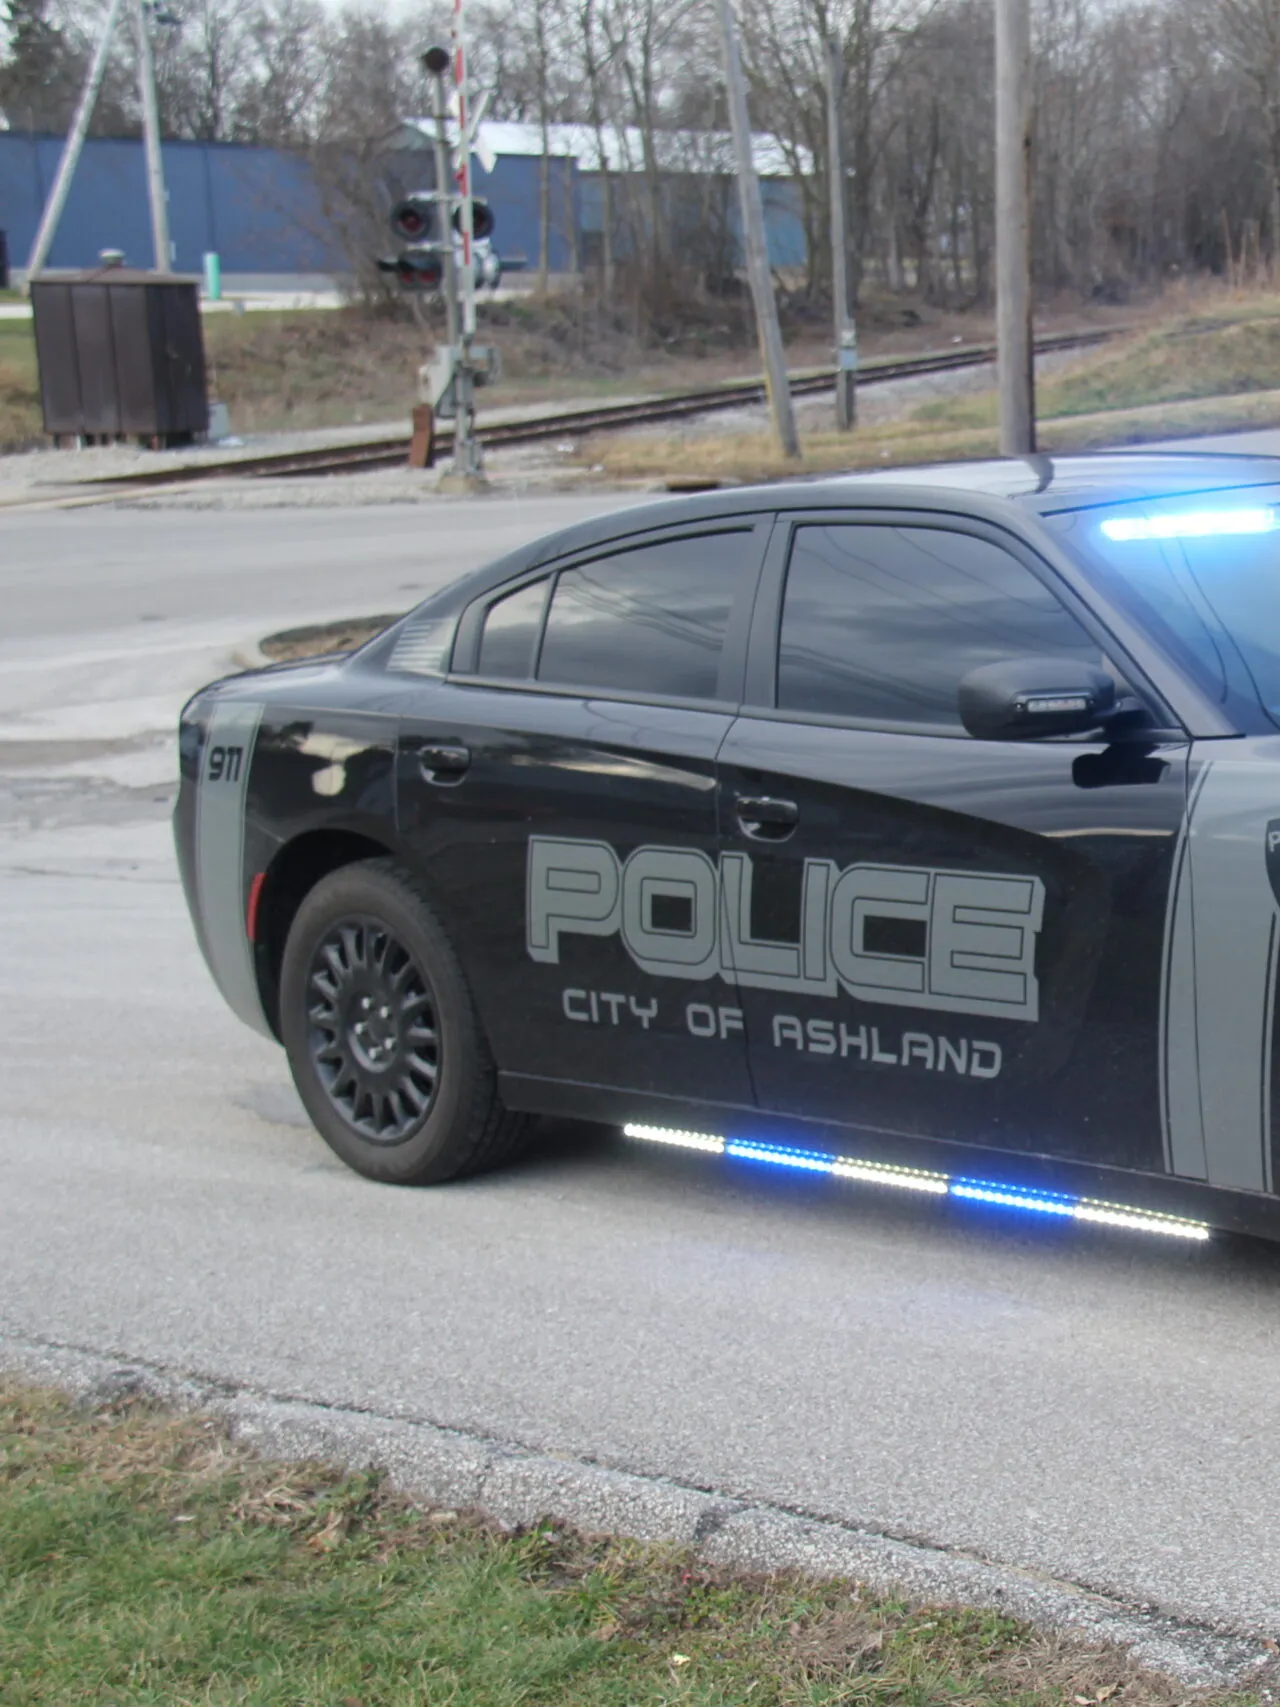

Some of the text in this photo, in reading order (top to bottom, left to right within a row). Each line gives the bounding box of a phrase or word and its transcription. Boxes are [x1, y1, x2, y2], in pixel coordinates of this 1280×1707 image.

[208, 746, 244, 782] 911
[526, 834, 1046, 1023] POLICE
[562, 988, 1003, 1079] CITY OF ASHLAND
